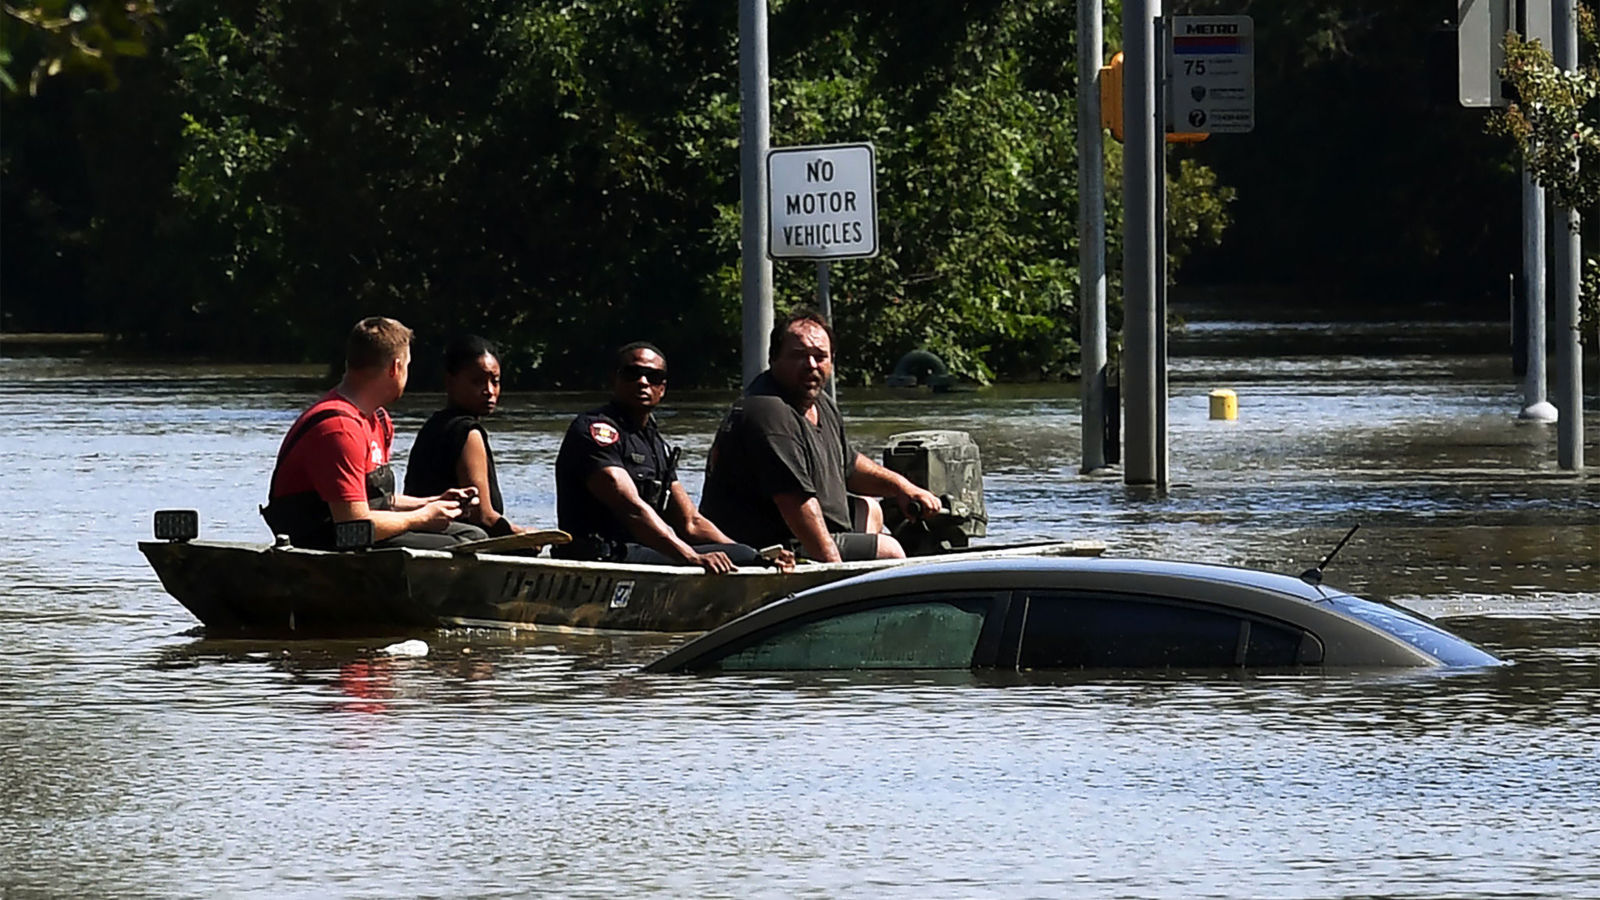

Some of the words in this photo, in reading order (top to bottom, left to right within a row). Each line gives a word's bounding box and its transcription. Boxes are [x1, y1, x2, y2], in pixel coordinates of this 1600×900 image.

[1185, 23, 1239, 34] METRO
[1183, 60, 1206, 76] 75
[807, 160, 834, 182] NO
[786, 191, 857, 215] MOTOR
[783, 221, 863, 246] VEHICLES
